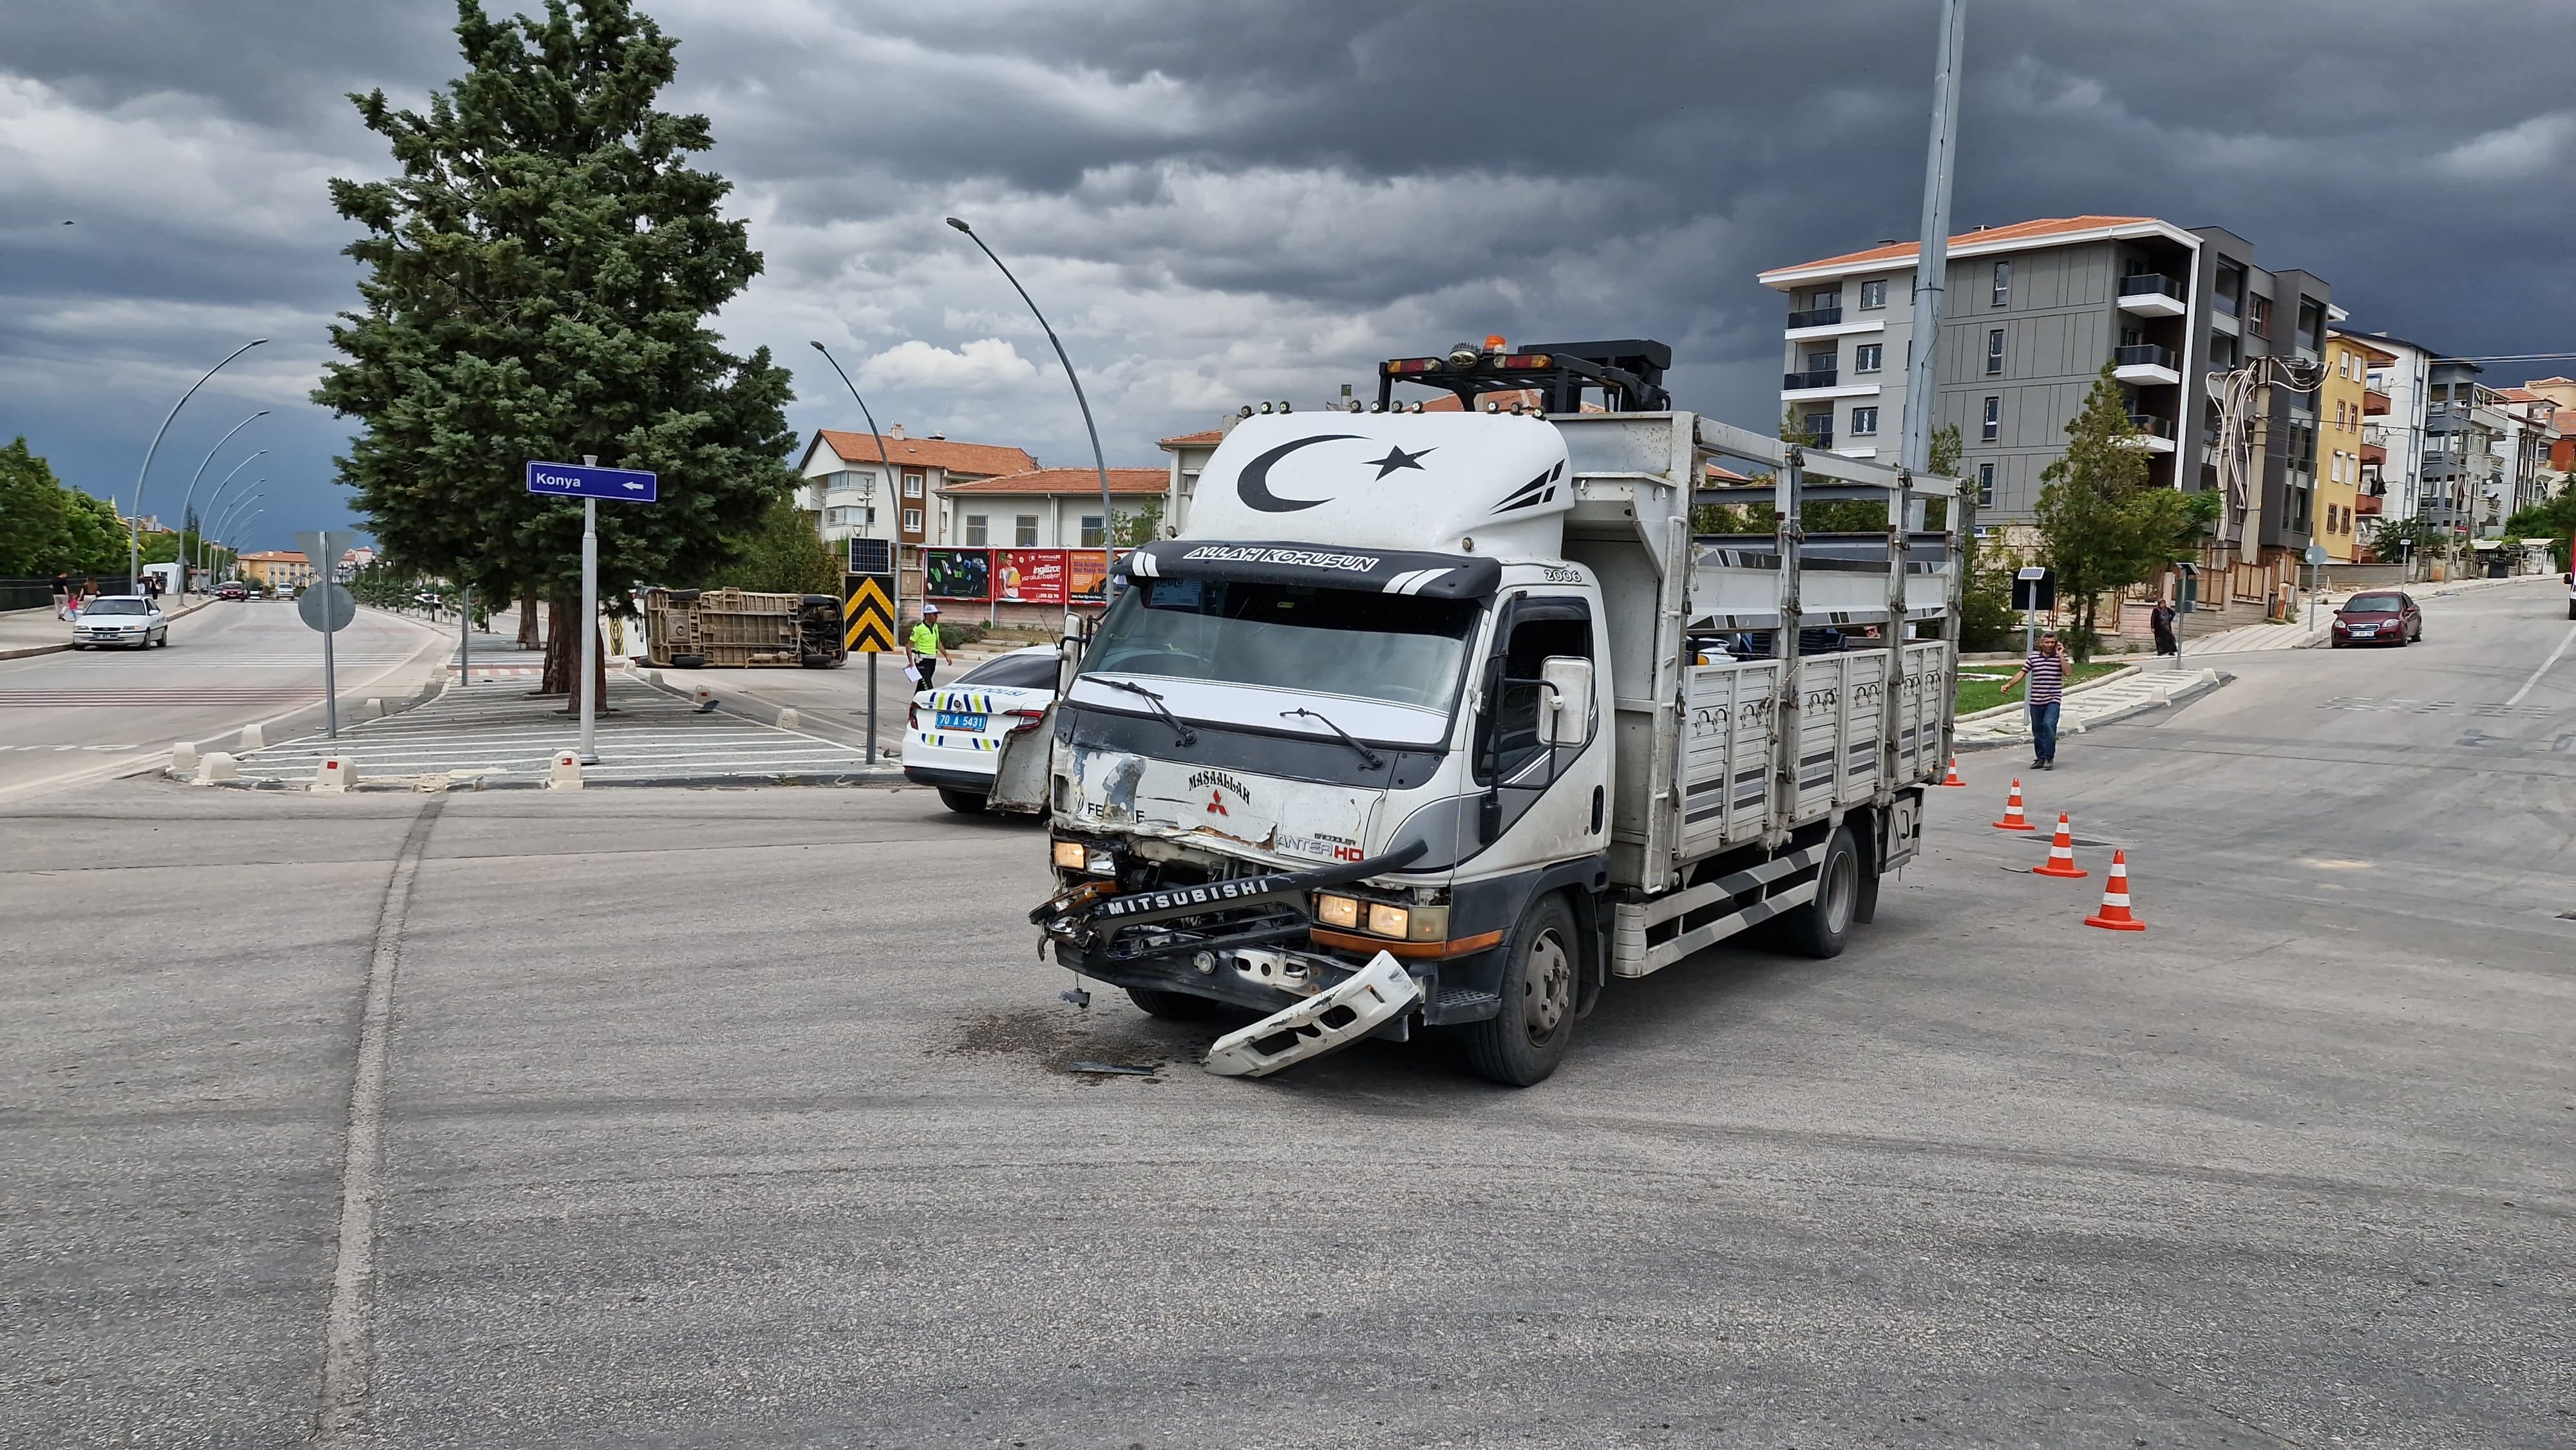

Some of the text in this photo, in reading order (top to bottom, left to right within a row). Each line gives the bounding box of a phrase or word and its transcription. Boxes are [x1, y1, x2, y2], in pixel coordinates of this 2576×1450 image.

[536, 473, 581, 489] Konya
[1183, 547, 1379, 572] ALLAH KORUSUN
[1544, 569, 1582, 583] 2006
[940, 715, 983, 727] 70 A 5431
[1189, 770, 1250, 807] MAŞAALLAH
[1334, 845, 1364, 862] HD
[1108, 880, 1269, 915] MITSUBISHI
